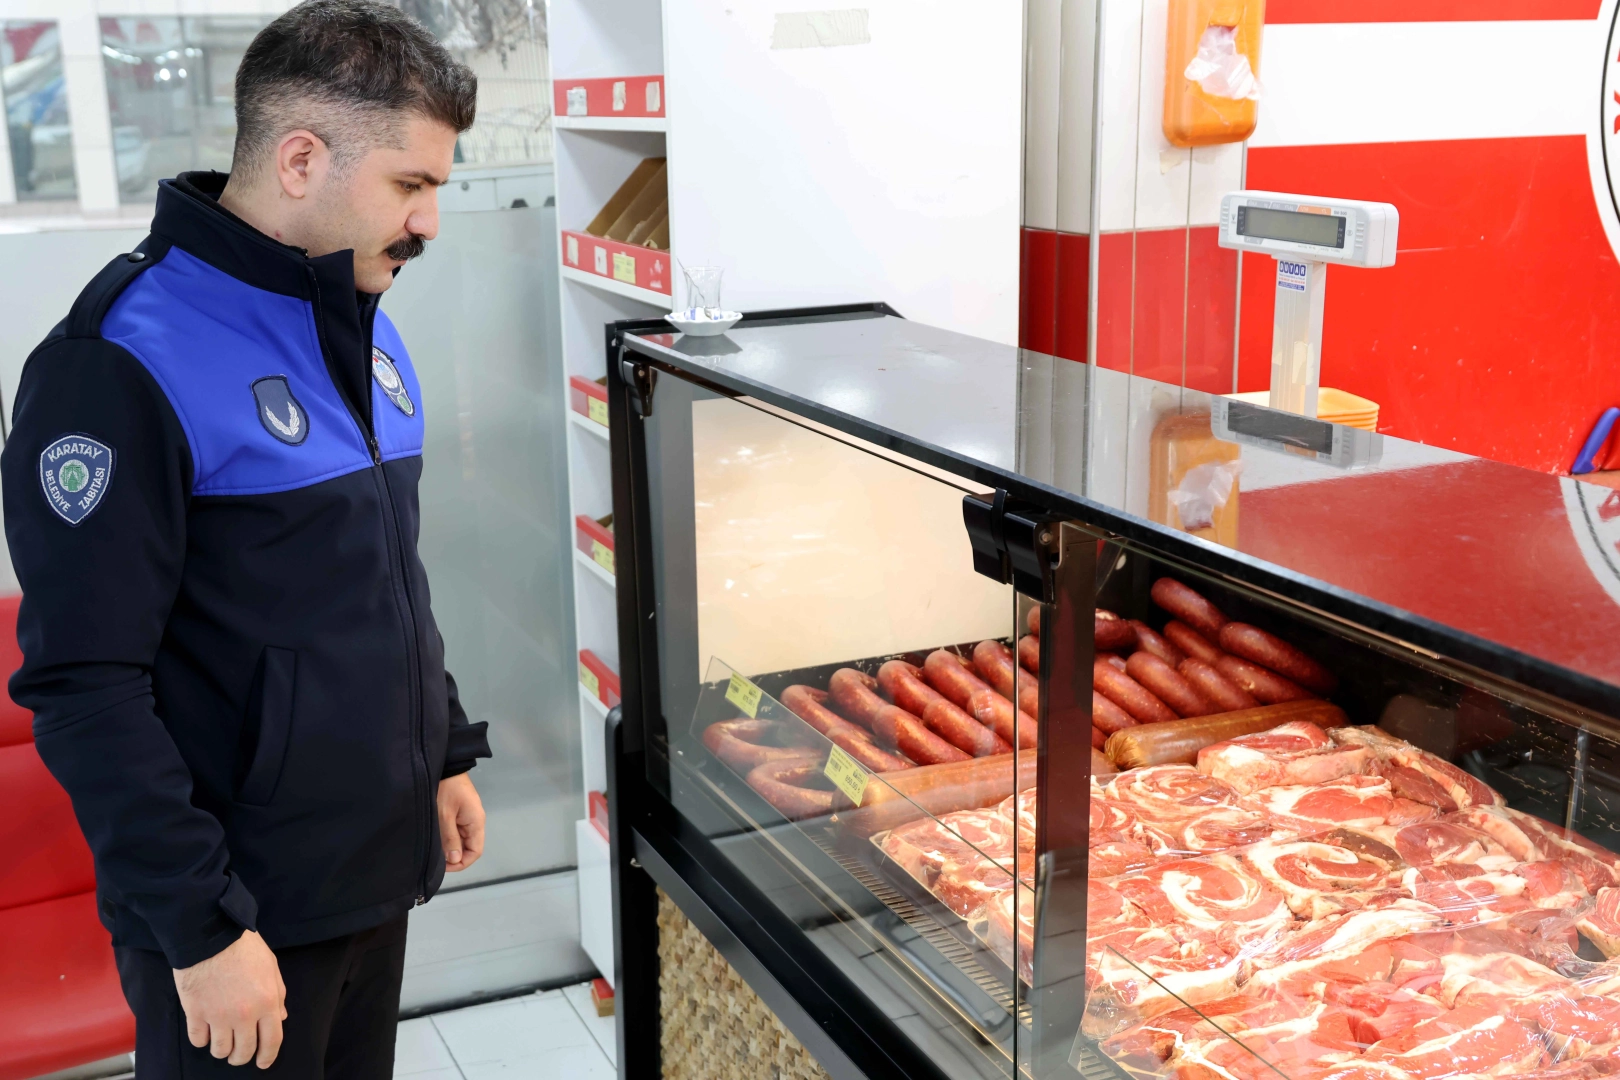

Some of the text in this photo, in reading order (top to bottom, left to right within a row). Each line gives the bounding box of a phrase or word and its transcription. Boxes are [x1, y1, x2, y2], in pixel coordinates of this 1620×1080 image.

[47, 443, 103, 462] KARATAY
[46, 470, 71, 511] BELEDİYE
[78, 467, 105, 510] ZABITASI
